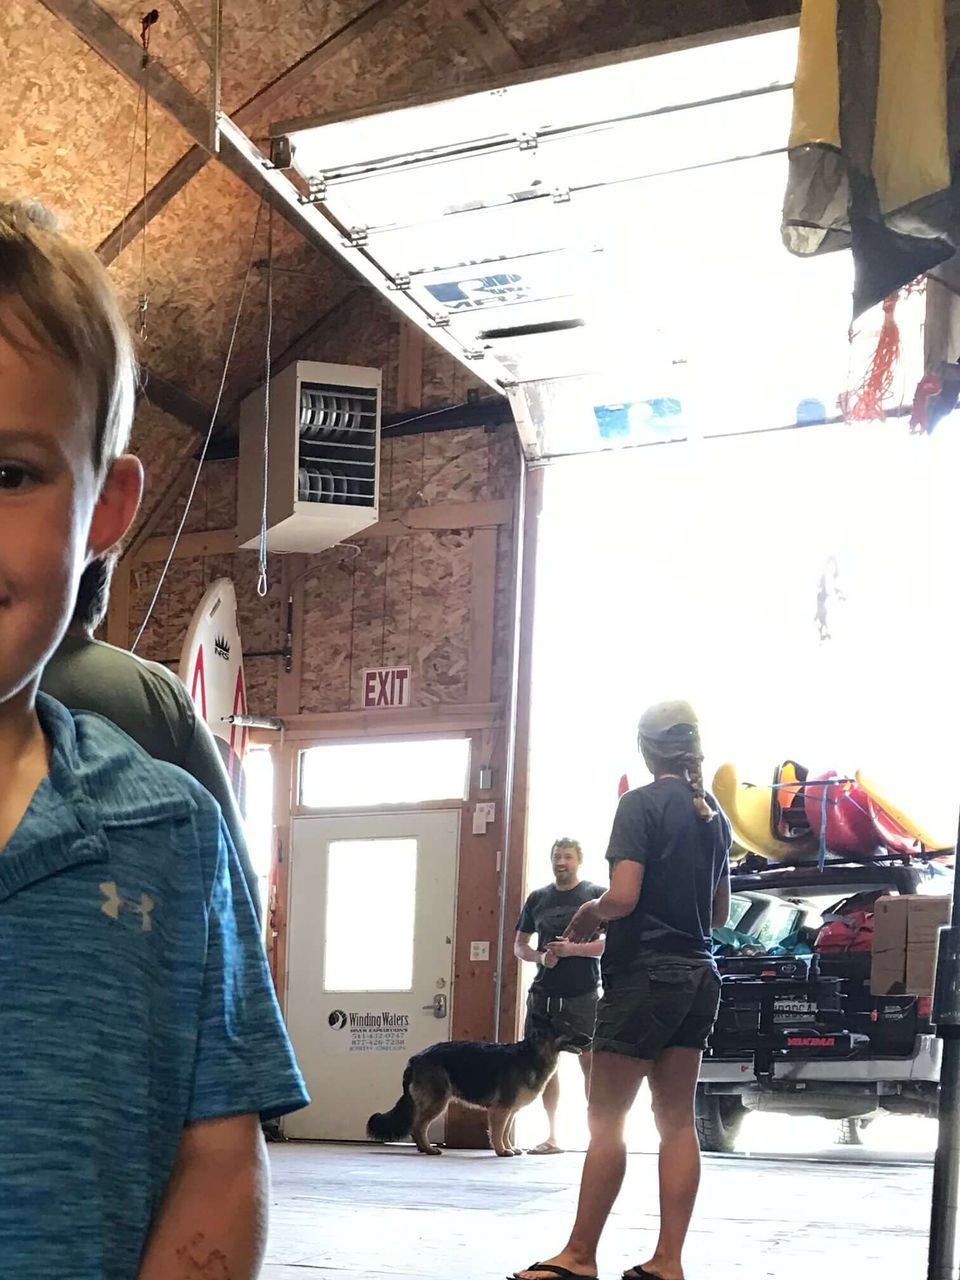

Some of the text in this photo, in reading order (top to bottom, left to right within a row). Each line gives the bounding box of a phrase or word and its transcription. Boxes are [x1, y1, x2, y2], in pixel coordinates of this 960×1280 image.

[214, 647, 230, 661] NRS
[365, 669, 408, 707] EXIT
[349, 1012, 409, 1028] Winding Waters
